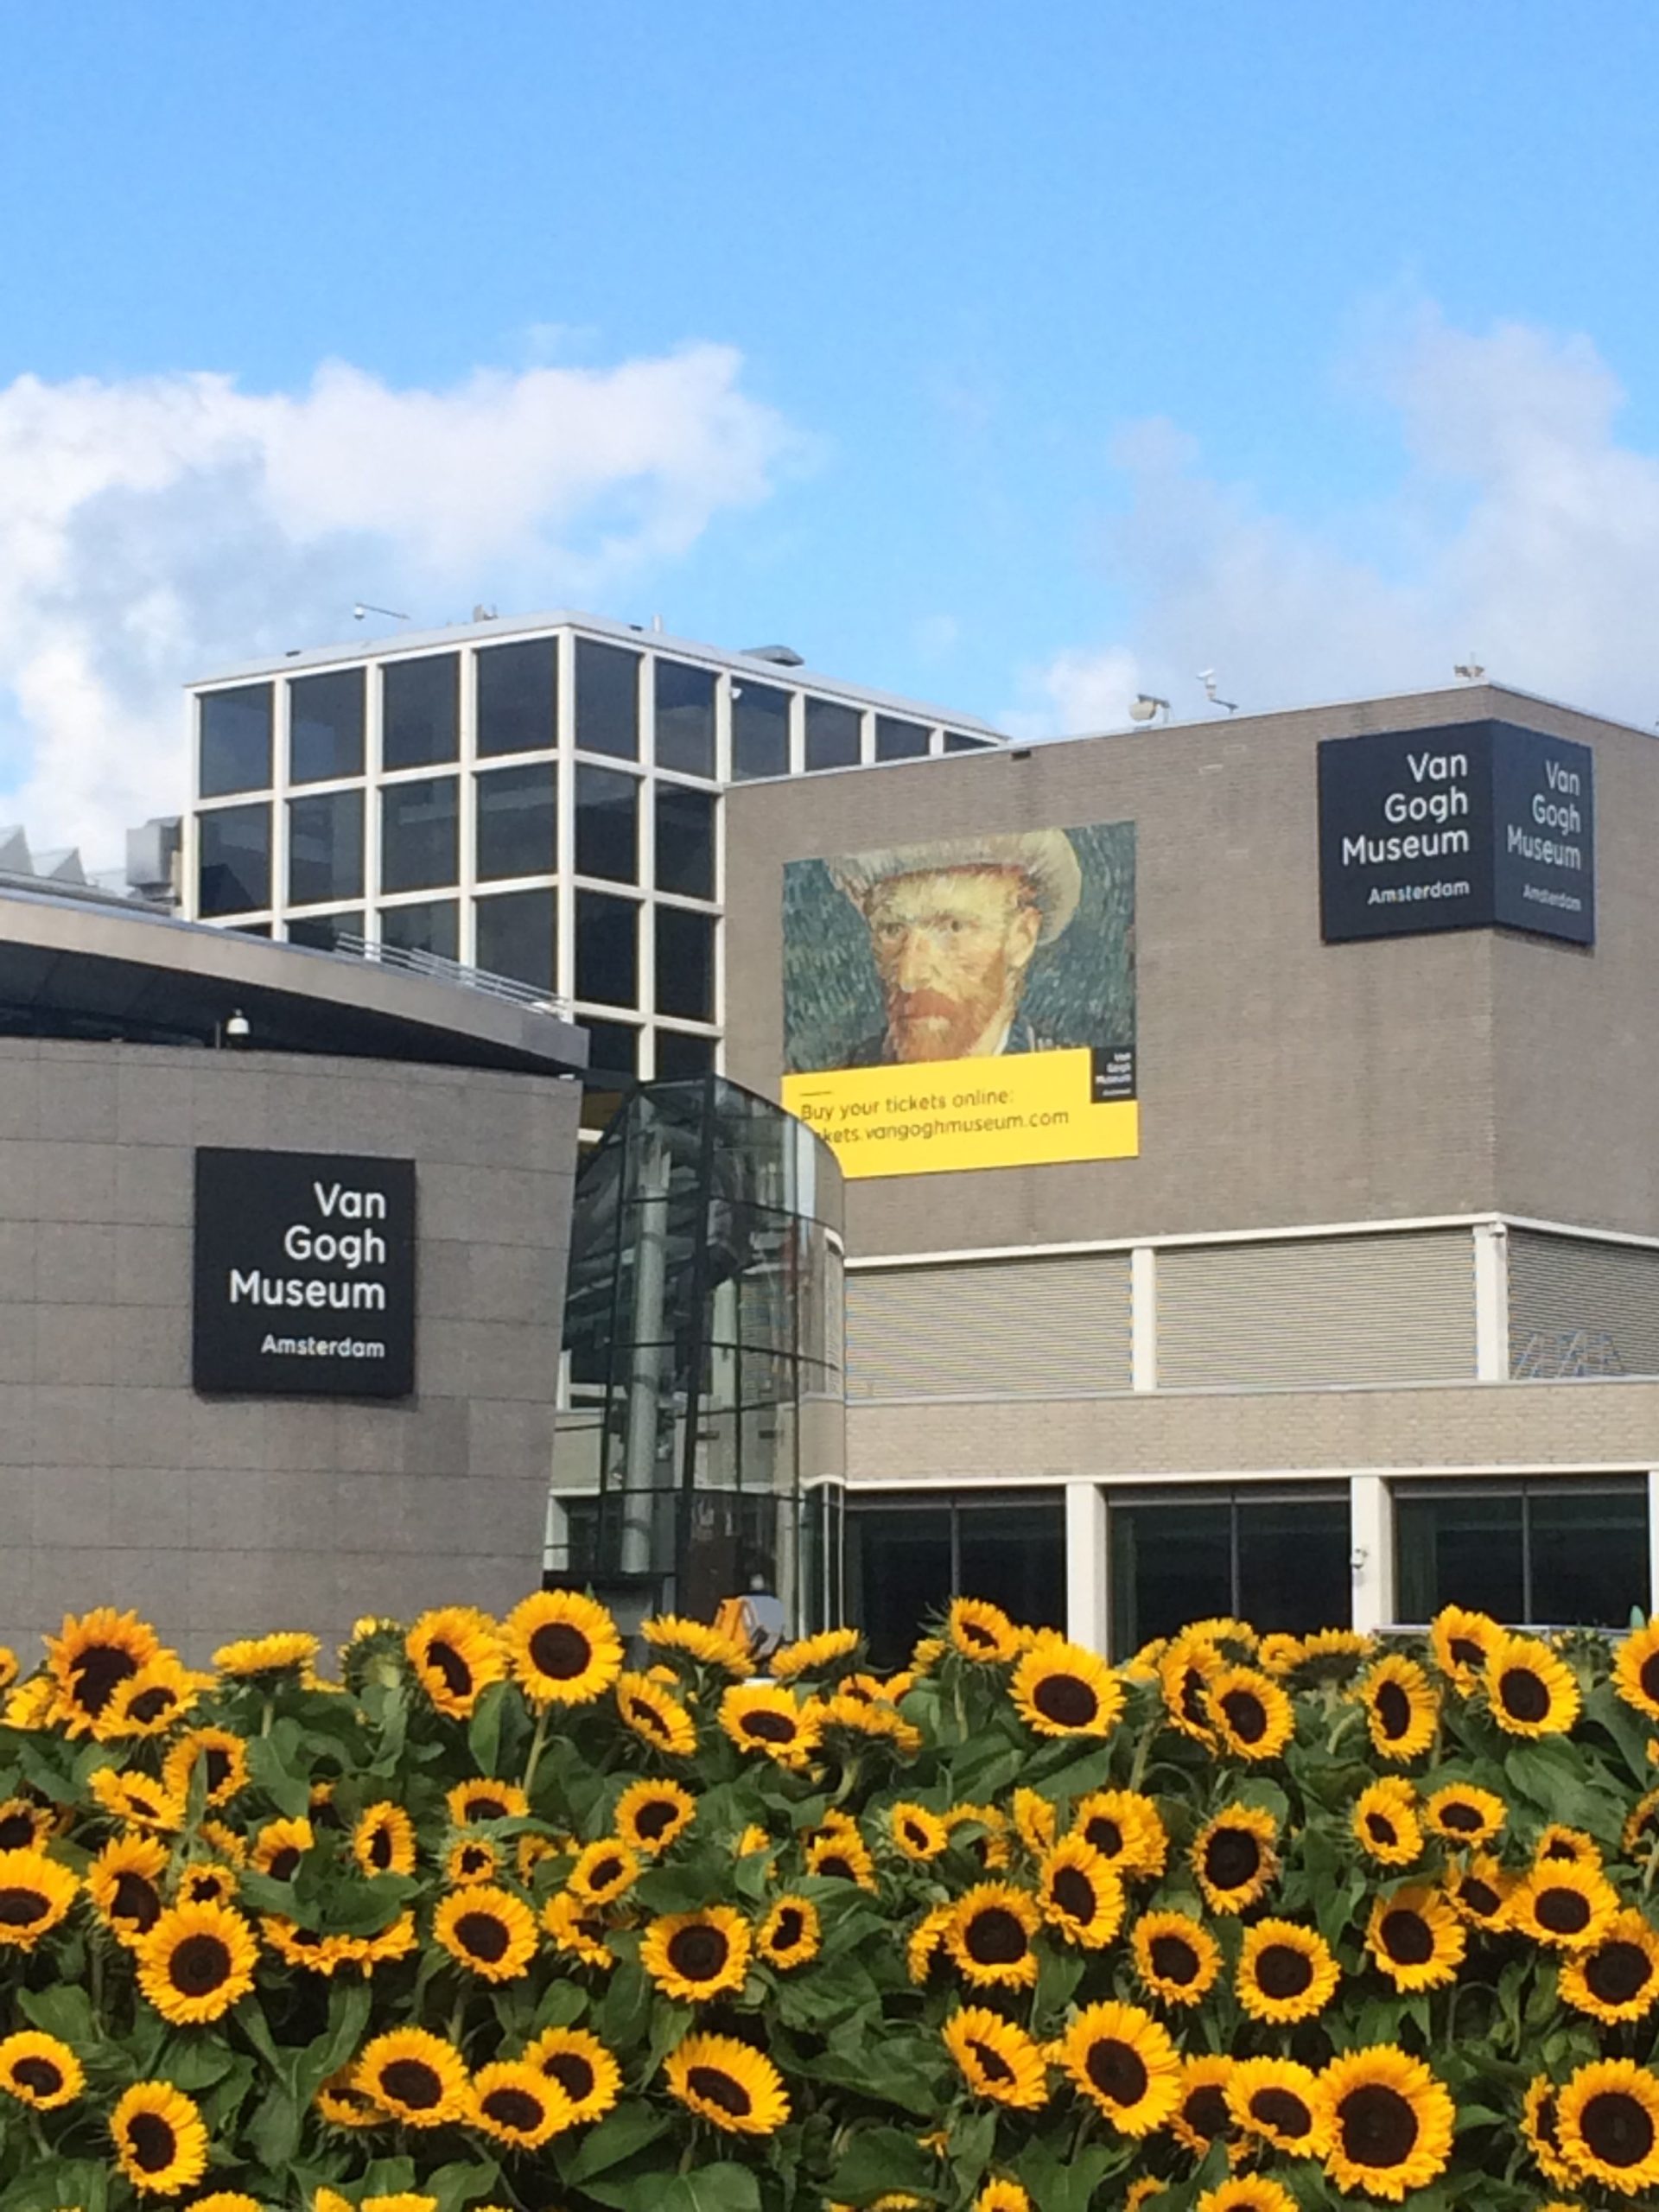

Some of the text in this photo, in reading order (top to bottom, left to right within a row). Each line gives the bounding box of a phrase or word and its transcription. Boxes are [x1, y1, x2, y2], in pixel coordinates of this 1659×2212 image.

[1407, 752, 1468, 783] Van
[1546, 760, 1580, 797] Van
[1384, 786, 1468, 824] Gogh
[1532, 793, 1581, 836] Gogh
[1342, 830, 1470, 866] Museum
[1507, 824, 1581, 870] Museum
[1368, 880, 1471, 906] Amsterdam
[1522, 883, 1582, 912] Amsterdam
[801, 1103, 835, 1122] Buy
[840, 1100, 880, 1121] your
[886, 1093, 946, 1114] tickets
[314, 1180, 387, 1219] Van
[284, 1224, 386, 1270] Gogh
[229, 1268, 386, 1312] Museum
[261, 1333, 386, 1358] Amsterdam
